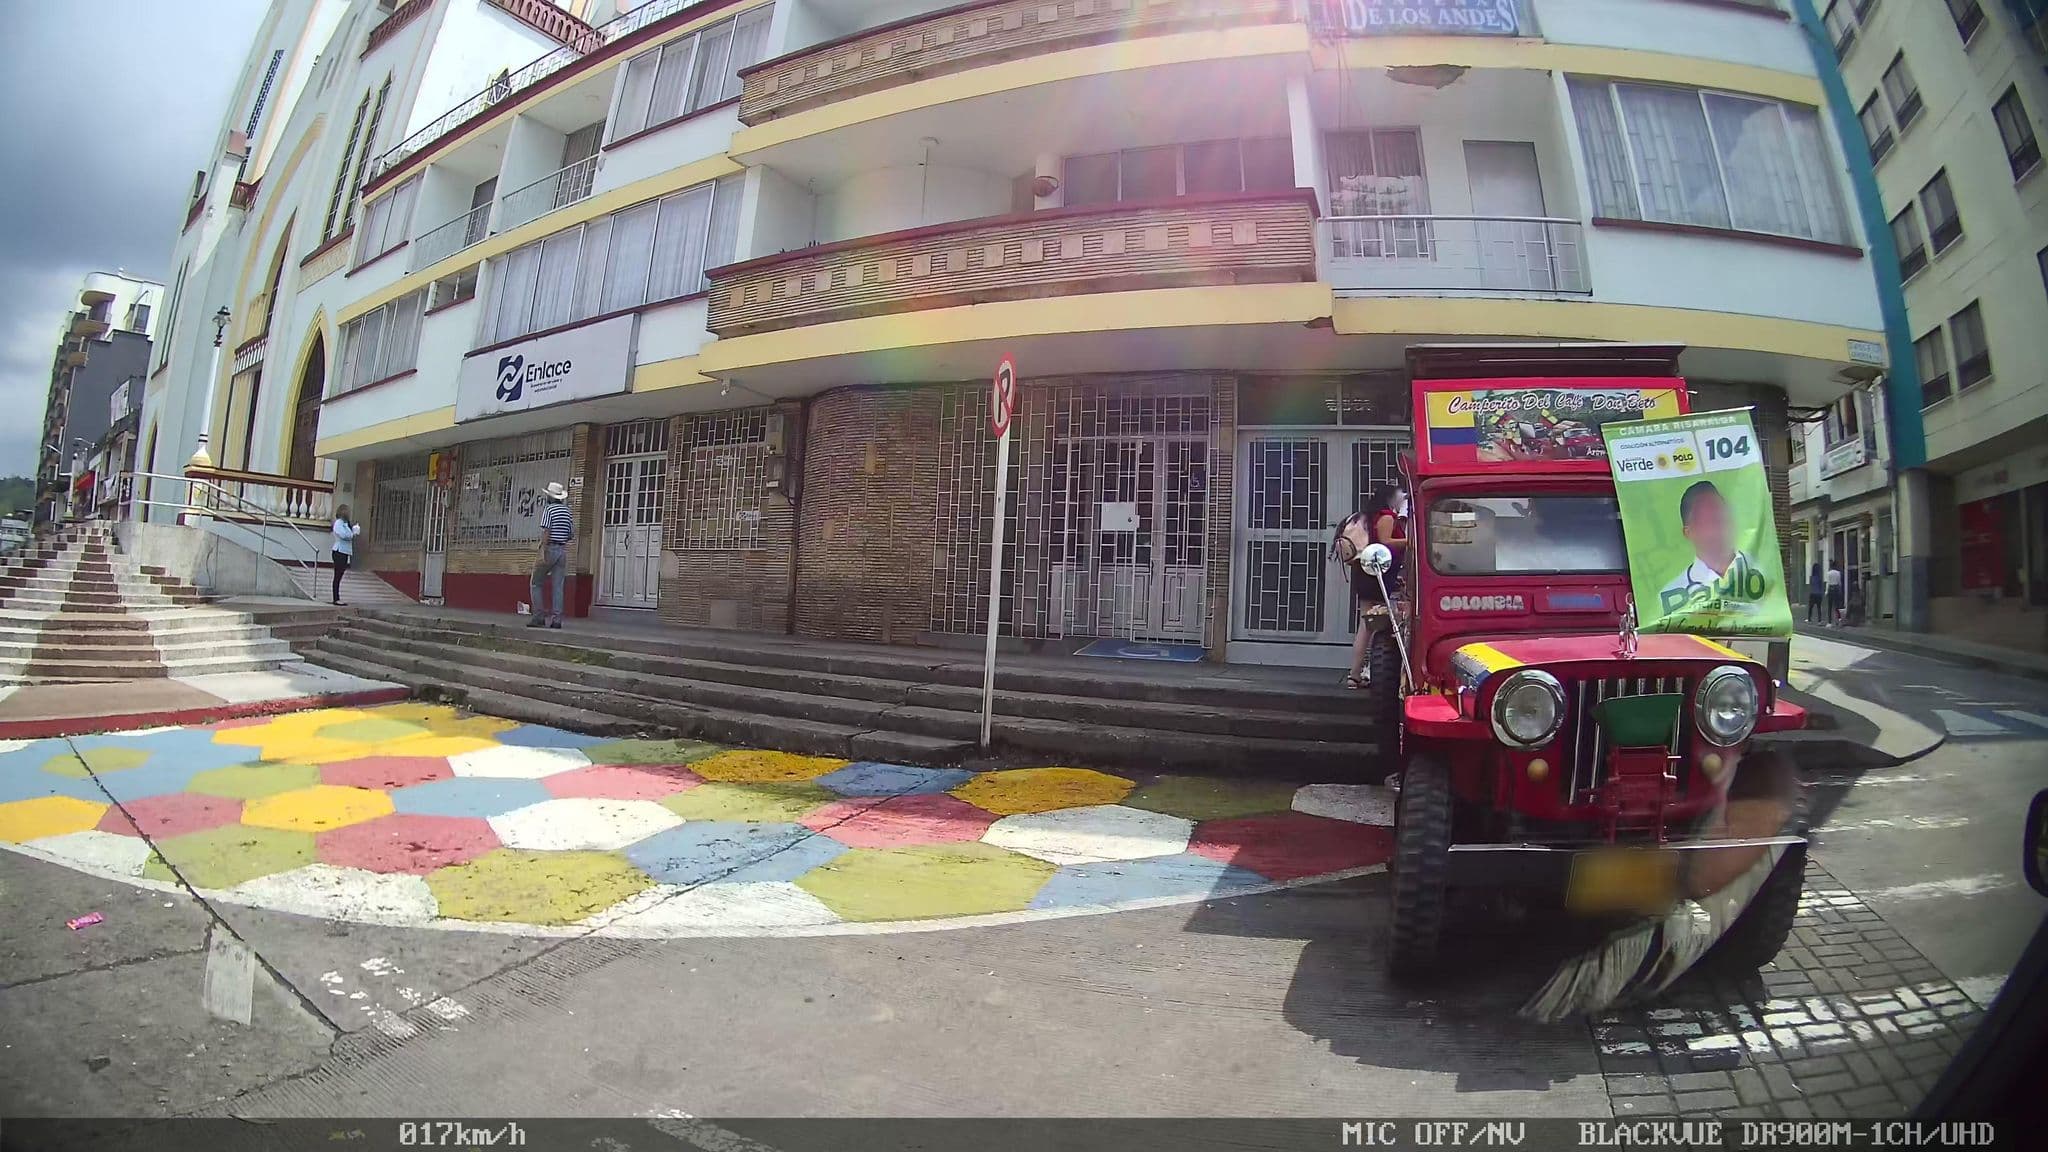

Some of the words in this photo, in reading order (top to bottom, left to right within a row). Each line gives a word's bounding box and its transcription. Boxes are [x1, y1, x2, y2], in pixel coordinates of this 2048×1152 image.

[1348, 0, 1383, 29] DE
[1387, 7, 1432, 25] LOS
[1438, 0, 1515, 31] ANDES
[526, 360, 572, 383] Enlace
[1448, 393, 1521, 418] Camperito
[1522, 392, 1550, 414] Del
[1592, 391, 1623, 411] Don
[1626, 391, 1657, 411] Beto
[1673, 416, 1737, 430] RISARALDA
[1672, 453, 1694, 463] POLO
[1705, 435, 1751, 461] 104
[1616, 457, 1654, 473] Verde
